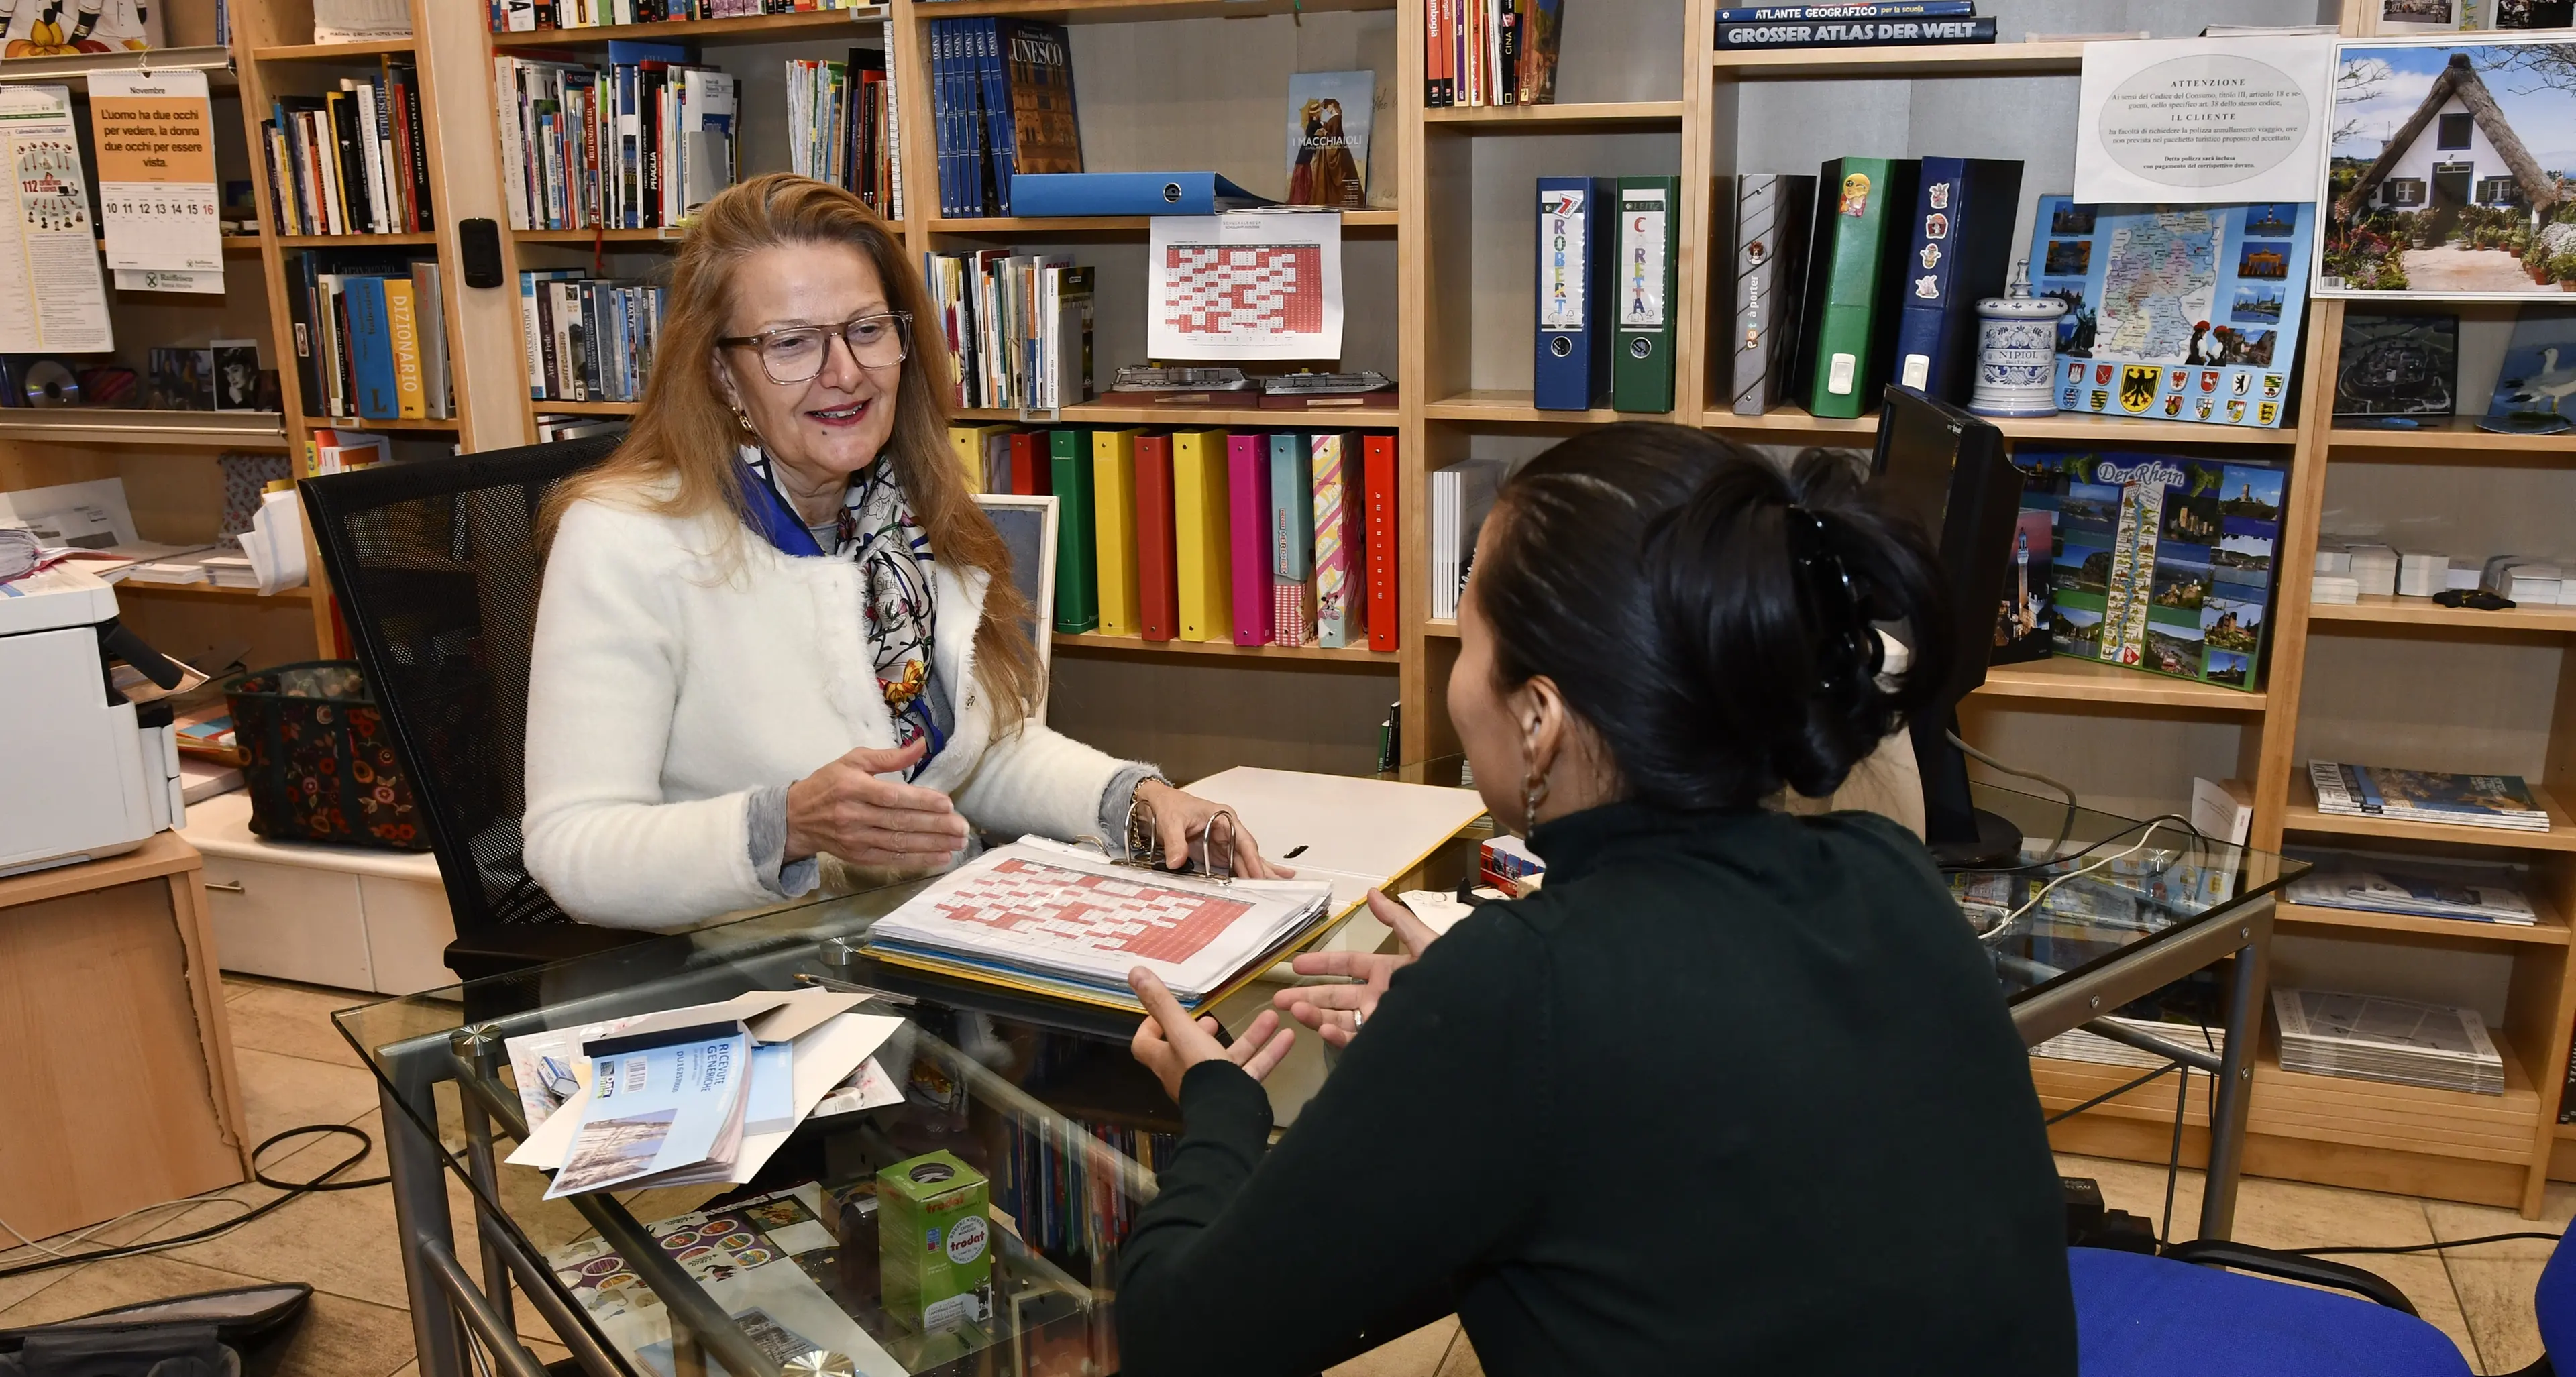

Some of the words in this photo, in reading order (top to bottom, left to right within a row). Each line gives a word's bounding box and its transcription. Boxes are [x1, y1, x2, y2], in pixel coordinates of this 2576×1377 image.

[1755, 9, 1801, 19] ATLANTE
[1805, 5, 1877, 19] GEOGRAFICO
[1728, 25, 1811, 44] GROSSER
[1814, 24, 1874, 41] ATLAS
[1878, 23, 1918, 39] DER
[1922, 22, 1976, 38] WELT
[1011, 38, 1063, 66] UNESCO
[501, 66, 509, 95] Bolzano
[2171, 79, 2245, 87] ATTENZIONE
[101, 109, 136, 120] L'uomo
[138, 110, 151, 119] ha
[153, 110, 170, 120] due
[173, 109, 199, 120] occhi
[360, 90, 370, 125] etrusca
[376, 87, 390, 137] ETRUSCHI
[104, 127, 119, 137] per
[123, 126, 157, 137] vedere,
[159, 126, 168, 135] la
[170, 126, 199, 136] donna
[1299, 135, 1362, 146] MACCHIAIOLI
[2163, 136, 2194, 144] pacchetto
[2189, 127, 2212, 135] polizza
[105, 142, 122, 151] due
[125, 142, 151, 152] occhi
[154, 144, 169, 154] per
[172, 144, 203, 152] essere
[365, 128, 375, 158] civiltà
[143, 158, 168, 168] vista.
[413, 131, 424, 185] ARCHEOLOGIA
[22, 180, 38, 192] 112
[106, 203, 117, 213] 10
[122, 203, 133, 213] 11
[139, 204, 150, 214] 12
[155, 204, 166, 214] 13
[171, 204, 182, 214] 14
[186, 205, 198, 215] 15
[203, 205, 213, 215] 16
[1633, 202, 1661, 211] LEITZ
[1749, 275, 1759, 311] porter
[393, 296, 418, 392] DIZIONARIO
[544, 334, 553, 352] Fede
[527, 351, 536, 376] ABBAZIA
[1999, 351, 2038, 359] NIPIOL
[547, 361, 555, 378] Arte
[307, 447, 315, 471] CAP
[2100, 463, 2133, 482] Der
[2135, 462, 2184, 485] Rhein
[1278, 530, 1288, 574] MERENDE
[700, 1046, 717, 1092] GENERICHE
[714, 1044, 729, 1085] RICEVUTE
[604, 1076, 614, 1095] Data
[951, 1231, 985, 1252] trodat
